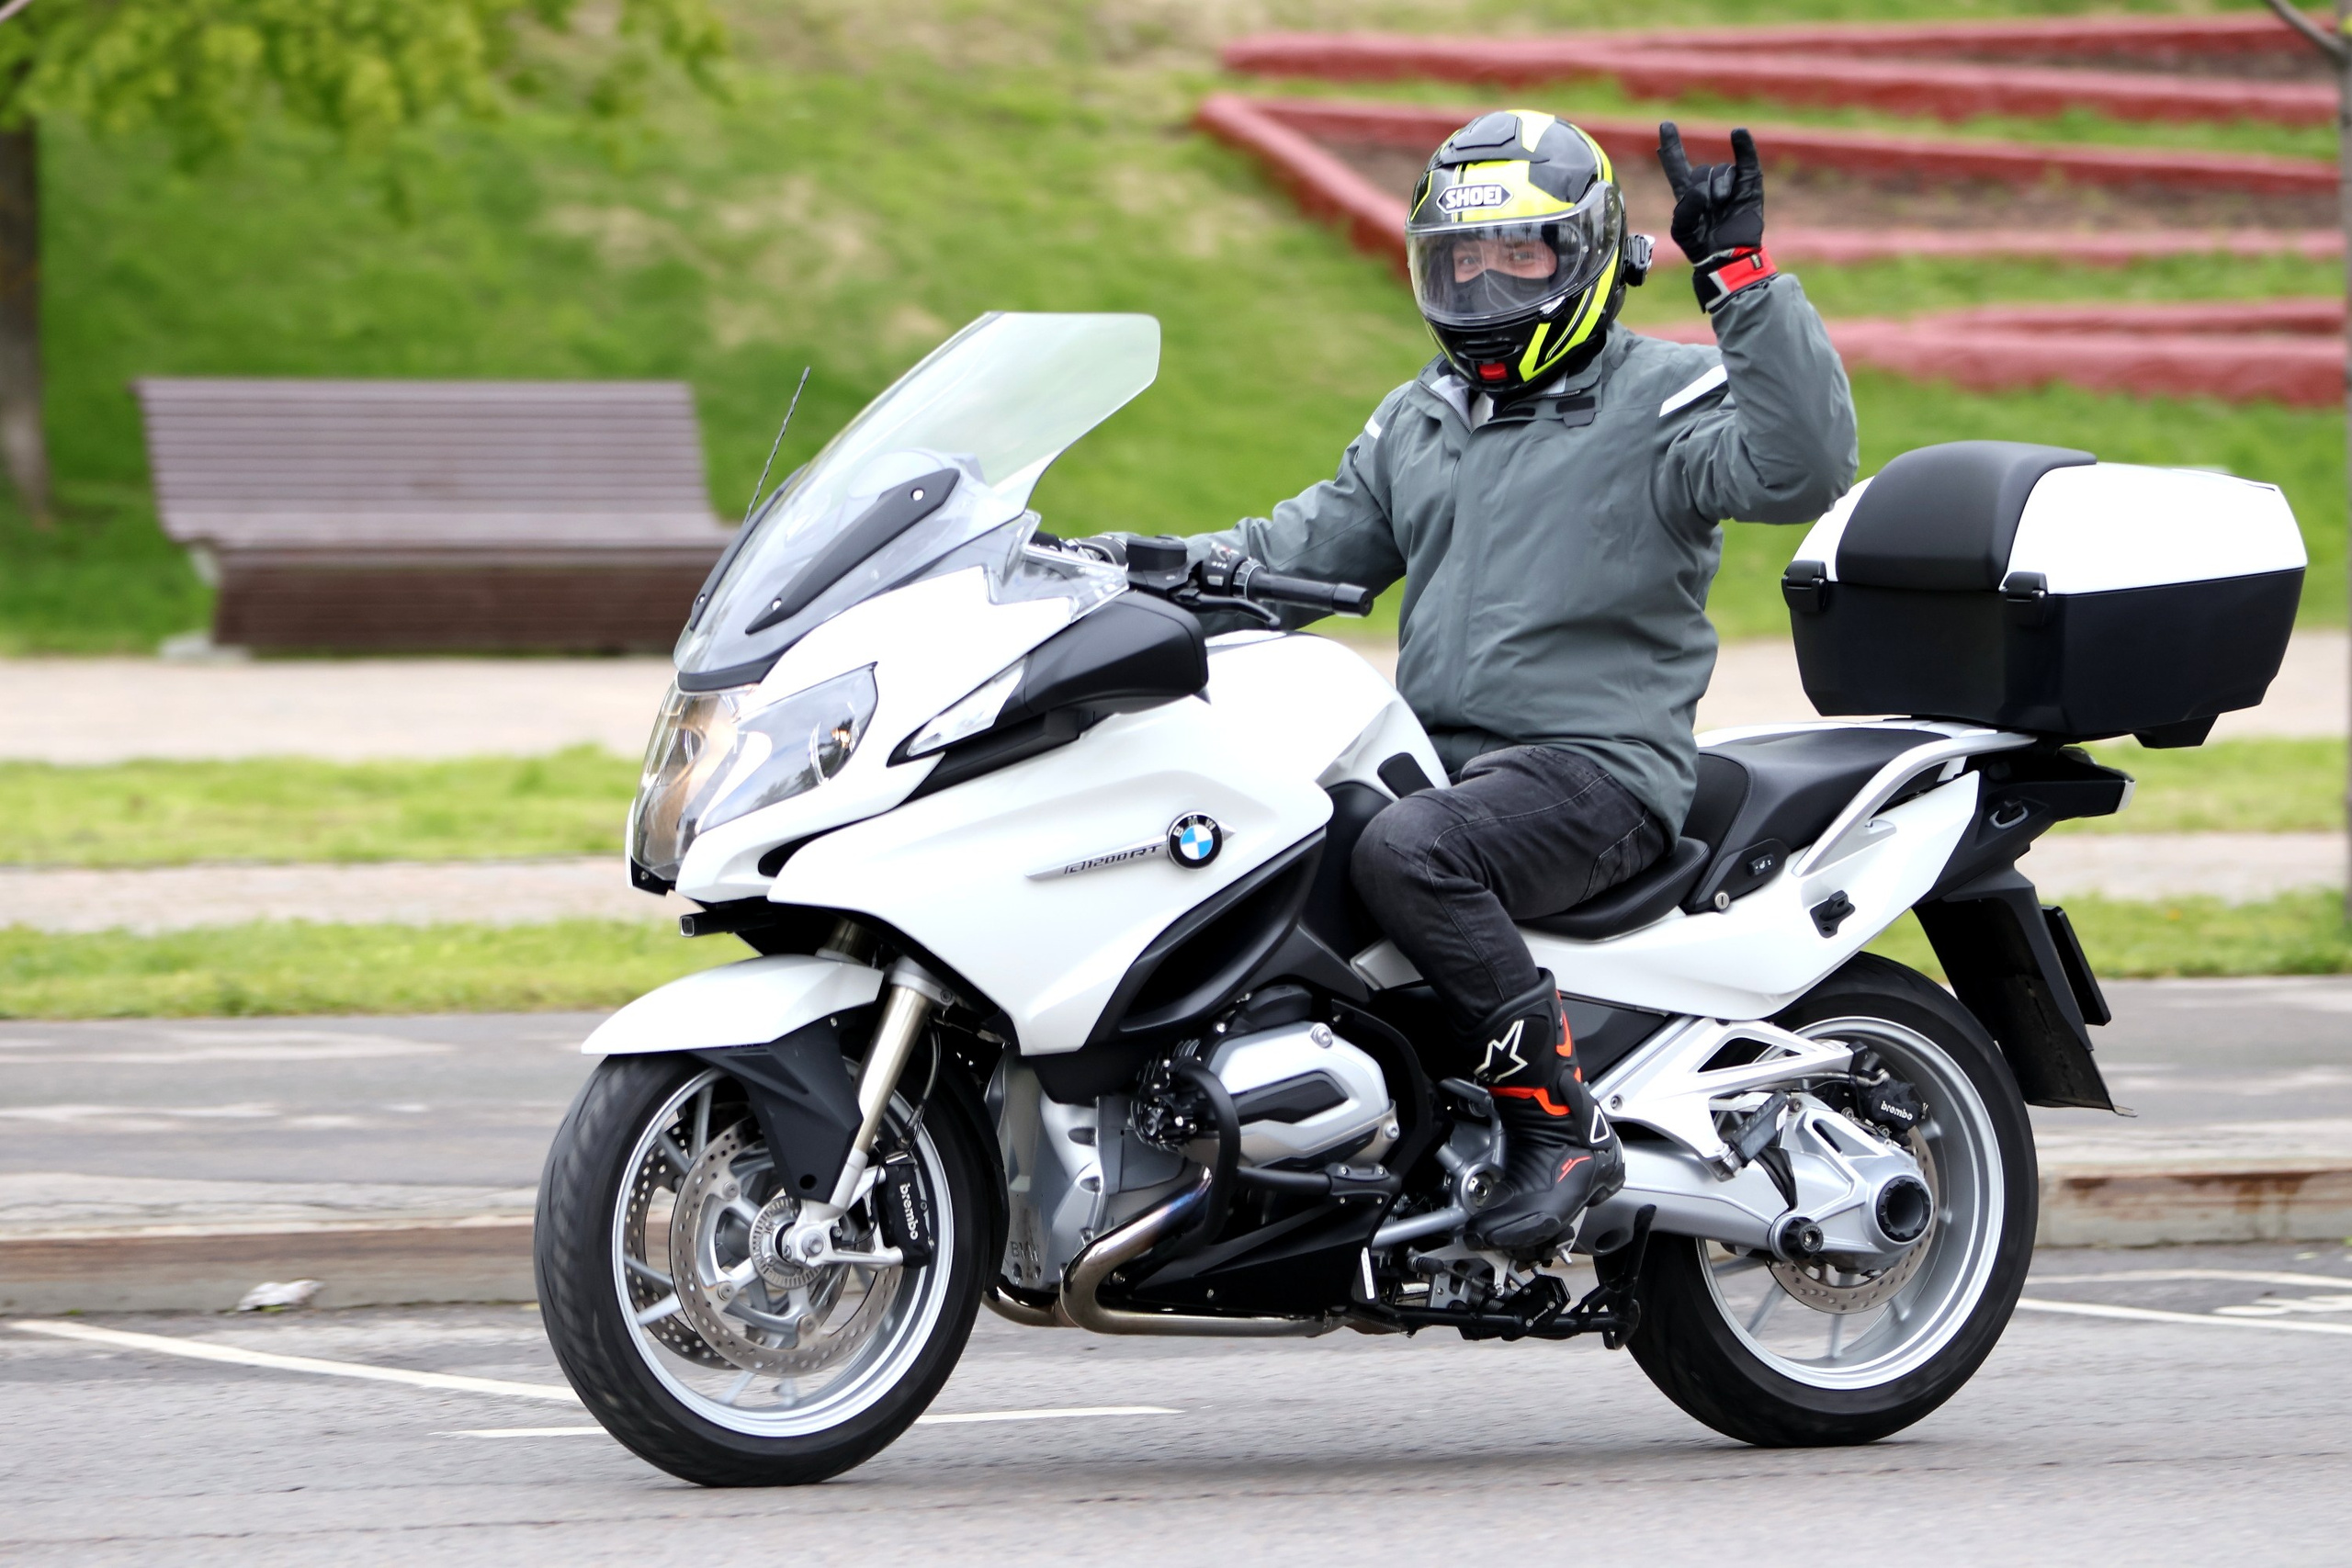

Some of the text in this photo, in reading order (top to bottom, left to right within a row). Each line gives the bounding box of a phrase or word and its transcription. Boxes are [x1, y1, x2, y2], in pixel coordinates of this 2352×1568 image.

[1445, 186, 1502, 209] SHOEI
[1172, 815, 1216, 838] BMW
[1880, 1100, 1913, 1121] brembo
[899, 1182, 919, 1241] brembo
